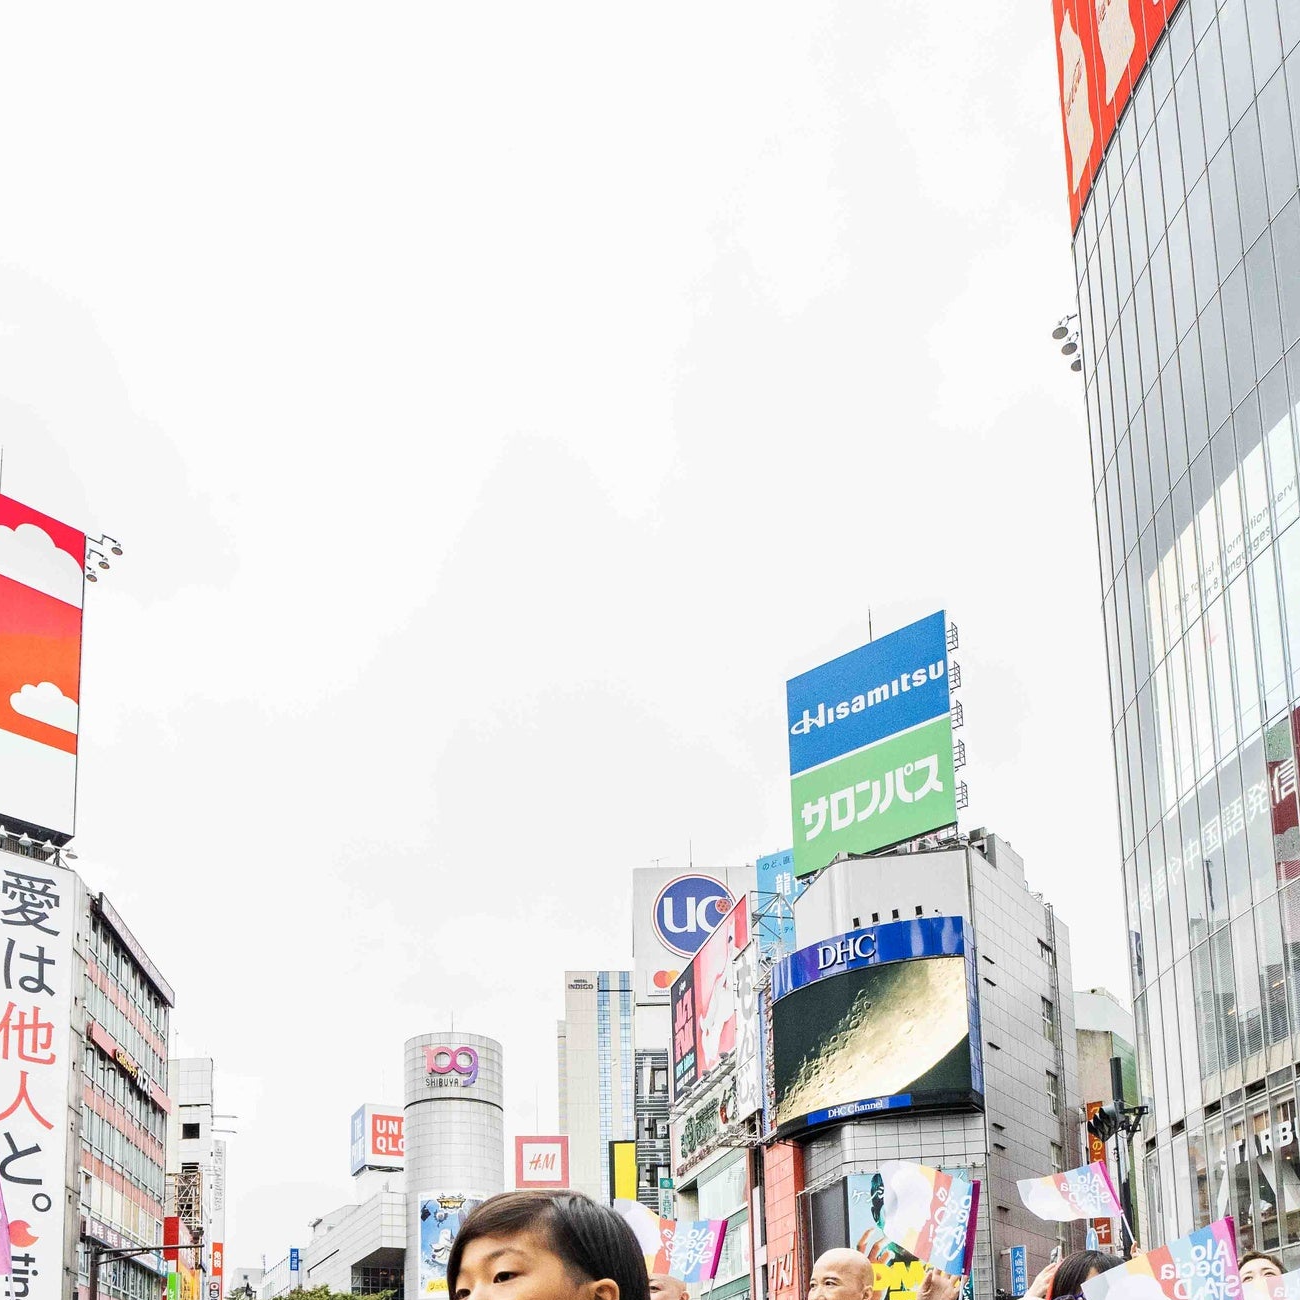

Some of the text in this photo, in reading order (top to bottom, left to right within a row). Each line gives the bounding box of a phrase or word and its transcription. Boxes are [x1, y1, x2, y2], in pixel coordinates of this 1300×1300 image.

[791, 660, 944, 735] Hisamitsu
[801, 754, 944, 841] サロンパス
[818, 933, 876, 971] DHC
[421, 1046, 479, 1087] 109
[425, 1077, 459, 1087] SHIBUYA
[827, 1100, 883, 1119] DHC Channel
[528, 1152, 556, 1172] H&M
